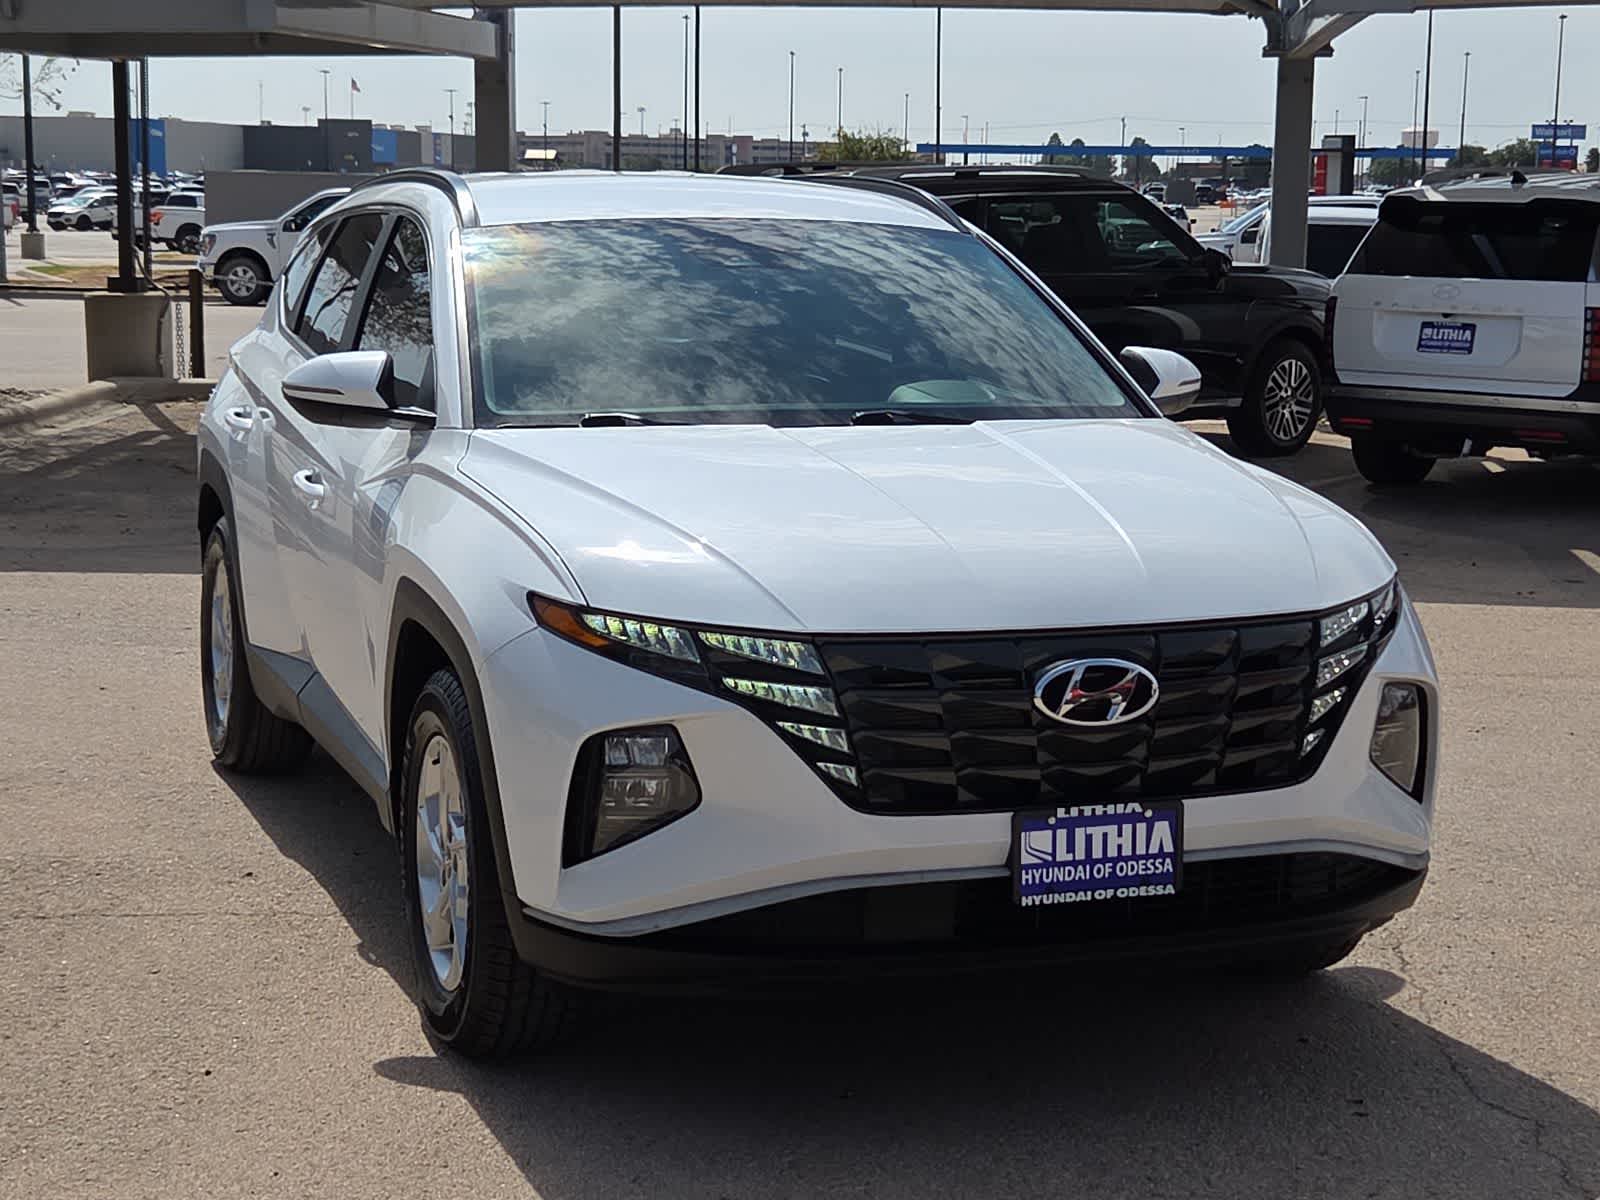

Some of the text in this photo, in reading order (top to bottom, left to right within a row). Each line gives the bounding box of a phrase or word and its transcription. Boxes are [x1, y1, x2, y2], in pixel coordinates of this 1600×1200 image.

[1432, 328, 1472, 341] LITHIA
[1056, 802, 1143, 818] LITHIA
[1055, 820, 1174, 862] LITHIA
[1021, 857, 1173, 885] HYUNDAI OF ODESSA
[1021, 884, 1175, 907] HYUNDAI OF ODESSA
